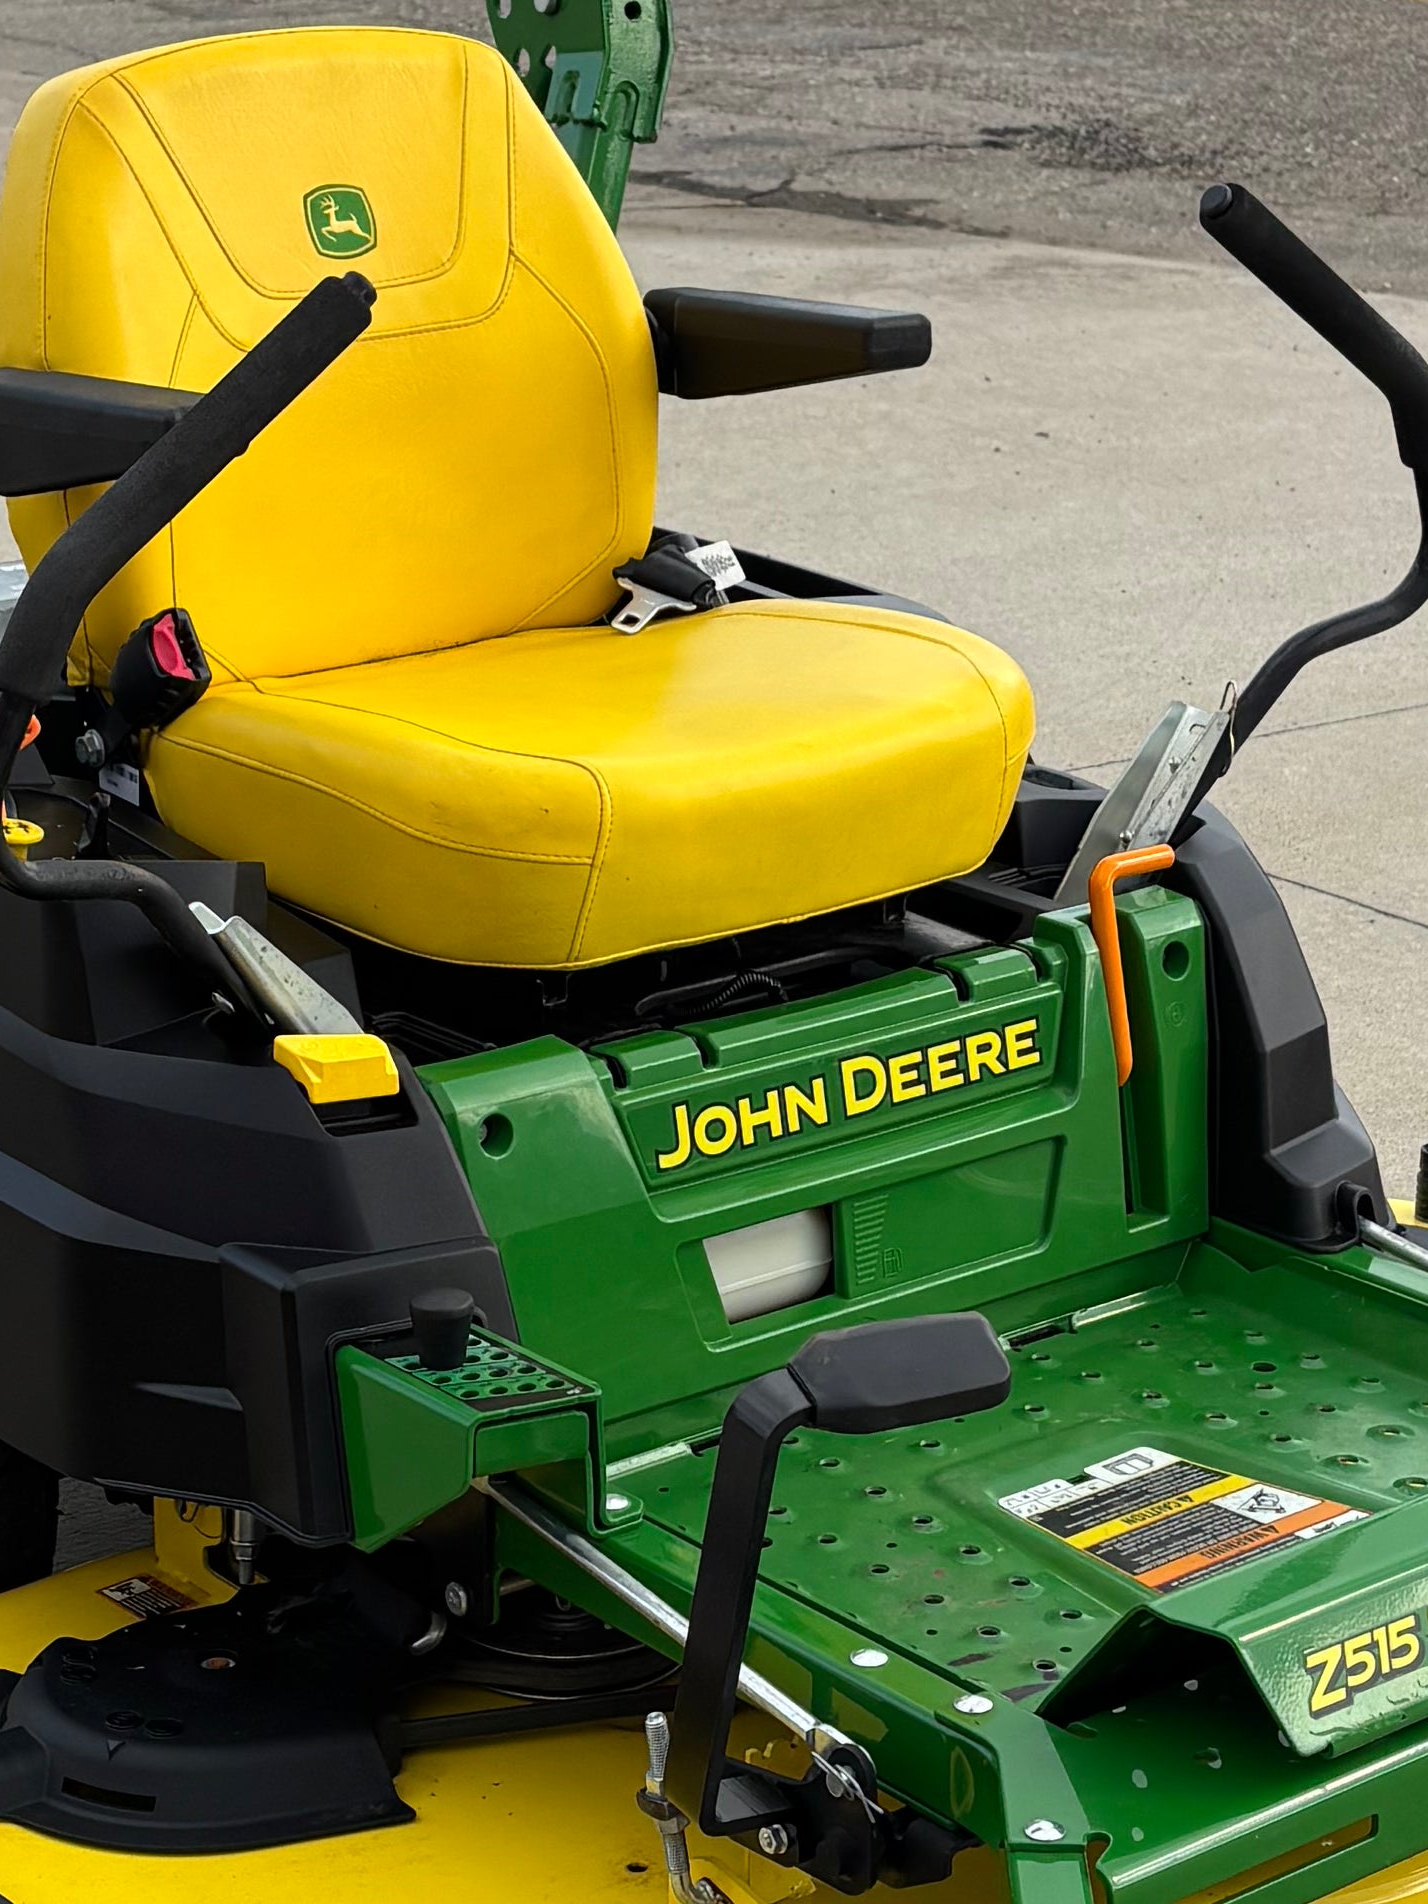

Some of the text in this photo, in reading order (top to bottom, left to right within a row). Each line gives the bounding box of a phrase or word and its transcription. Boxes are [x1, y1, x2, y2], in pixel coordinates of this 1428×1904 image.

[656, 1018, 1042, 1170] JOHN DEERE
[1120, 1498, 1182, 1527] CAUTION
[1199, 1528, 1265, 1561] WARNING
[1305, 1614, 1423, 1715] Z515
